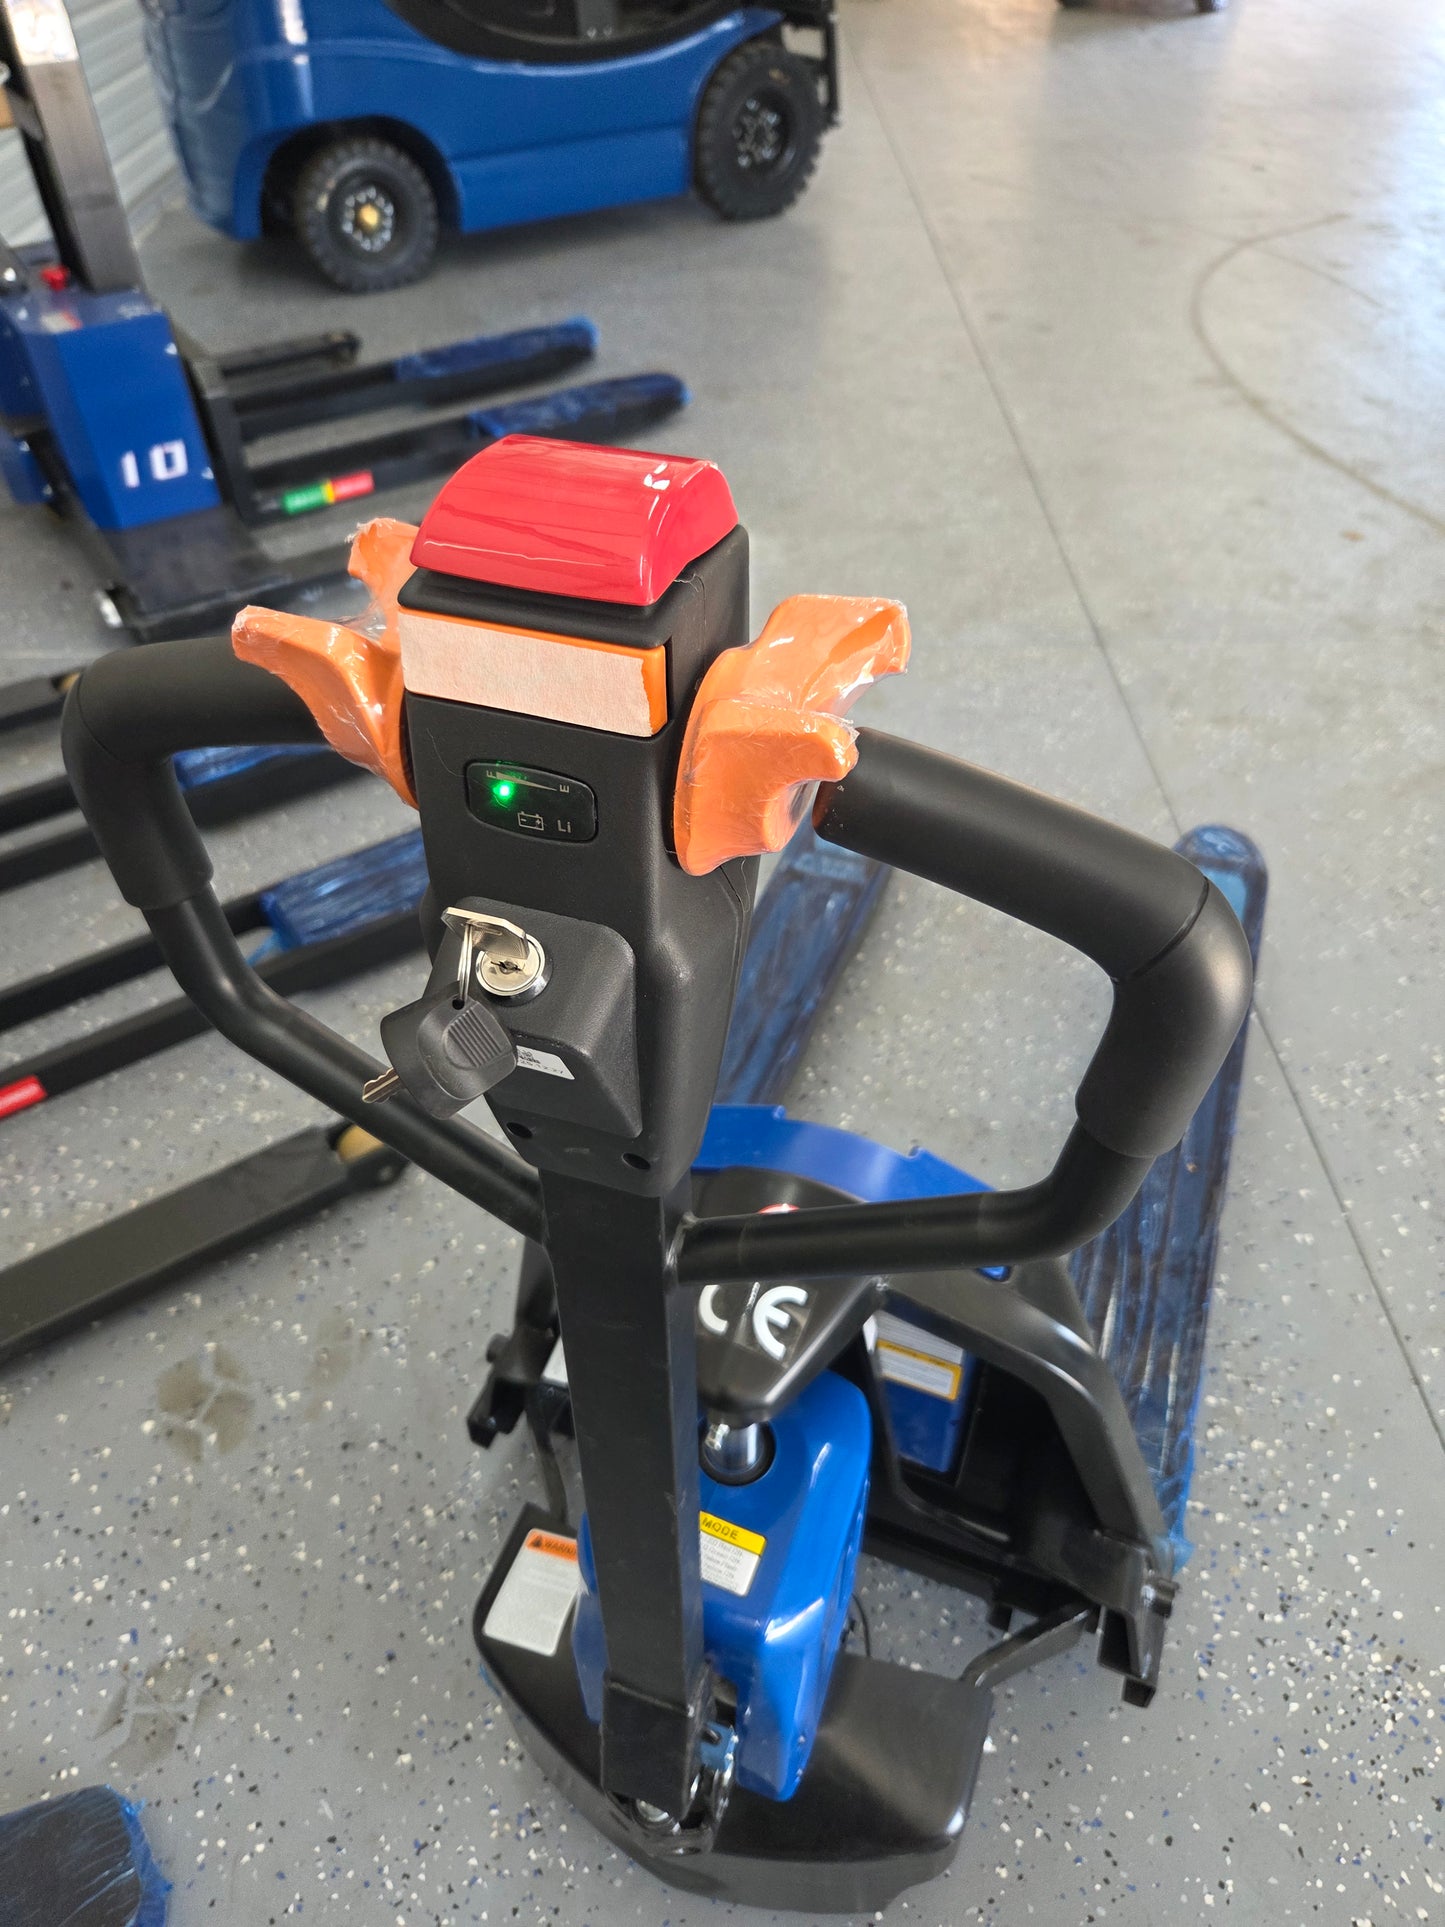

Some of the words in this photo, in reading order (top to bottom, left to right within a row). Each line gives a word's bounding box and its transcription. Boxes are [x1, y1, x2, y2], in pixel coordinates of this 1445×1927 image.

[121, 439, 188, 488] 10
[559, 784, 570, 793] E
[557, 819, 572, 834] Li
[698, 1285, 809, 1360] CE
[702, 1517, 739, 1540] MODE
